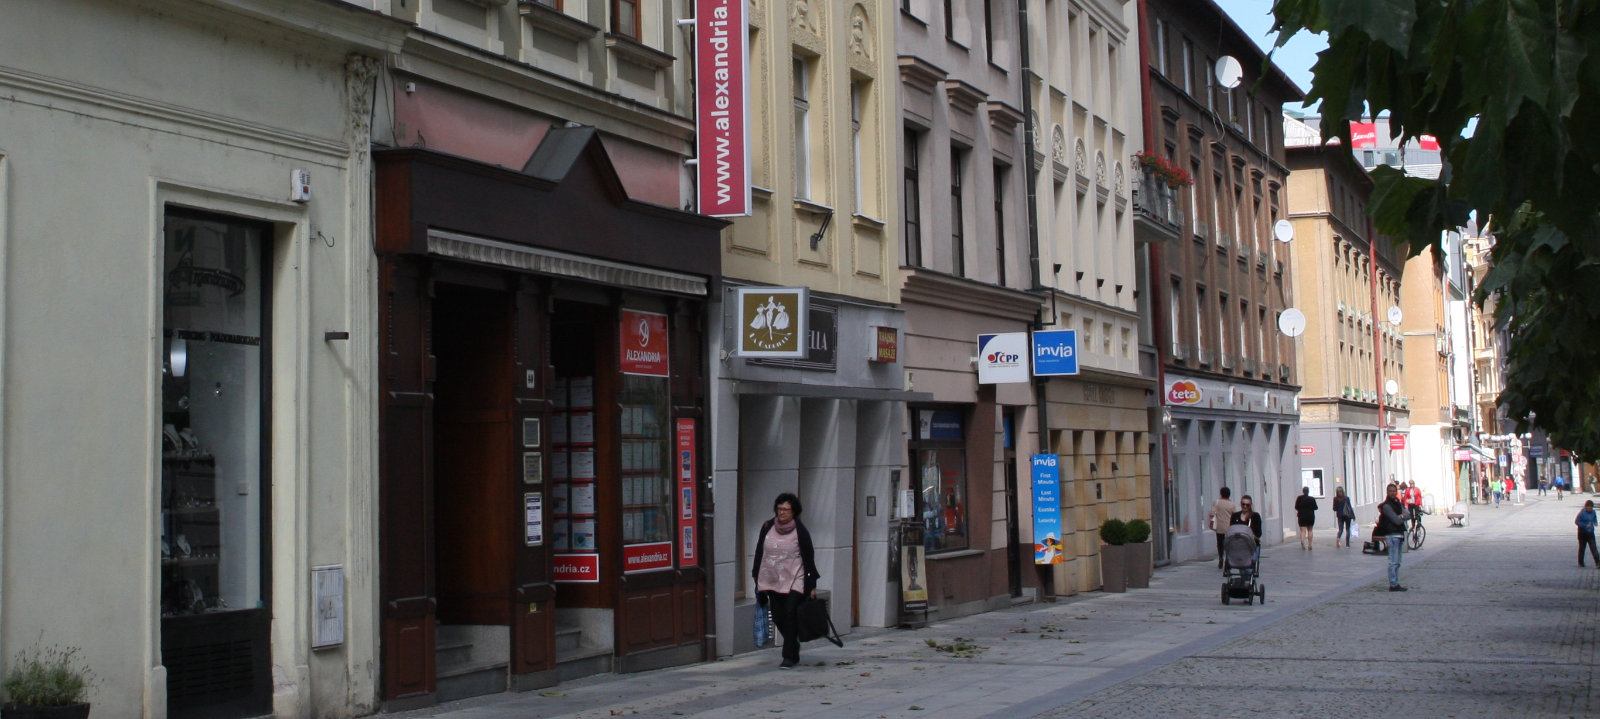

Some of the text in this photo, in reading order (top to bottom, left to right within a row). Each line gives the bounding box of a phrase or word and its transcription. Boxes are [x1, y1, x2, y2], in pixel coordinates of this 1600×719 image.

[709, 0, 730, 205] www.alexandria.
[626, 349, 660, 363] ALEXANDRIA
[999, 351, 1019, 363] ČPP
[1037, 343, 1073, 358] invia
[1172, 389, 1197, 399] teta
[1034, 457, 1056, 467] invia
[628, 552, 668, 565] www.alexandria.cz
